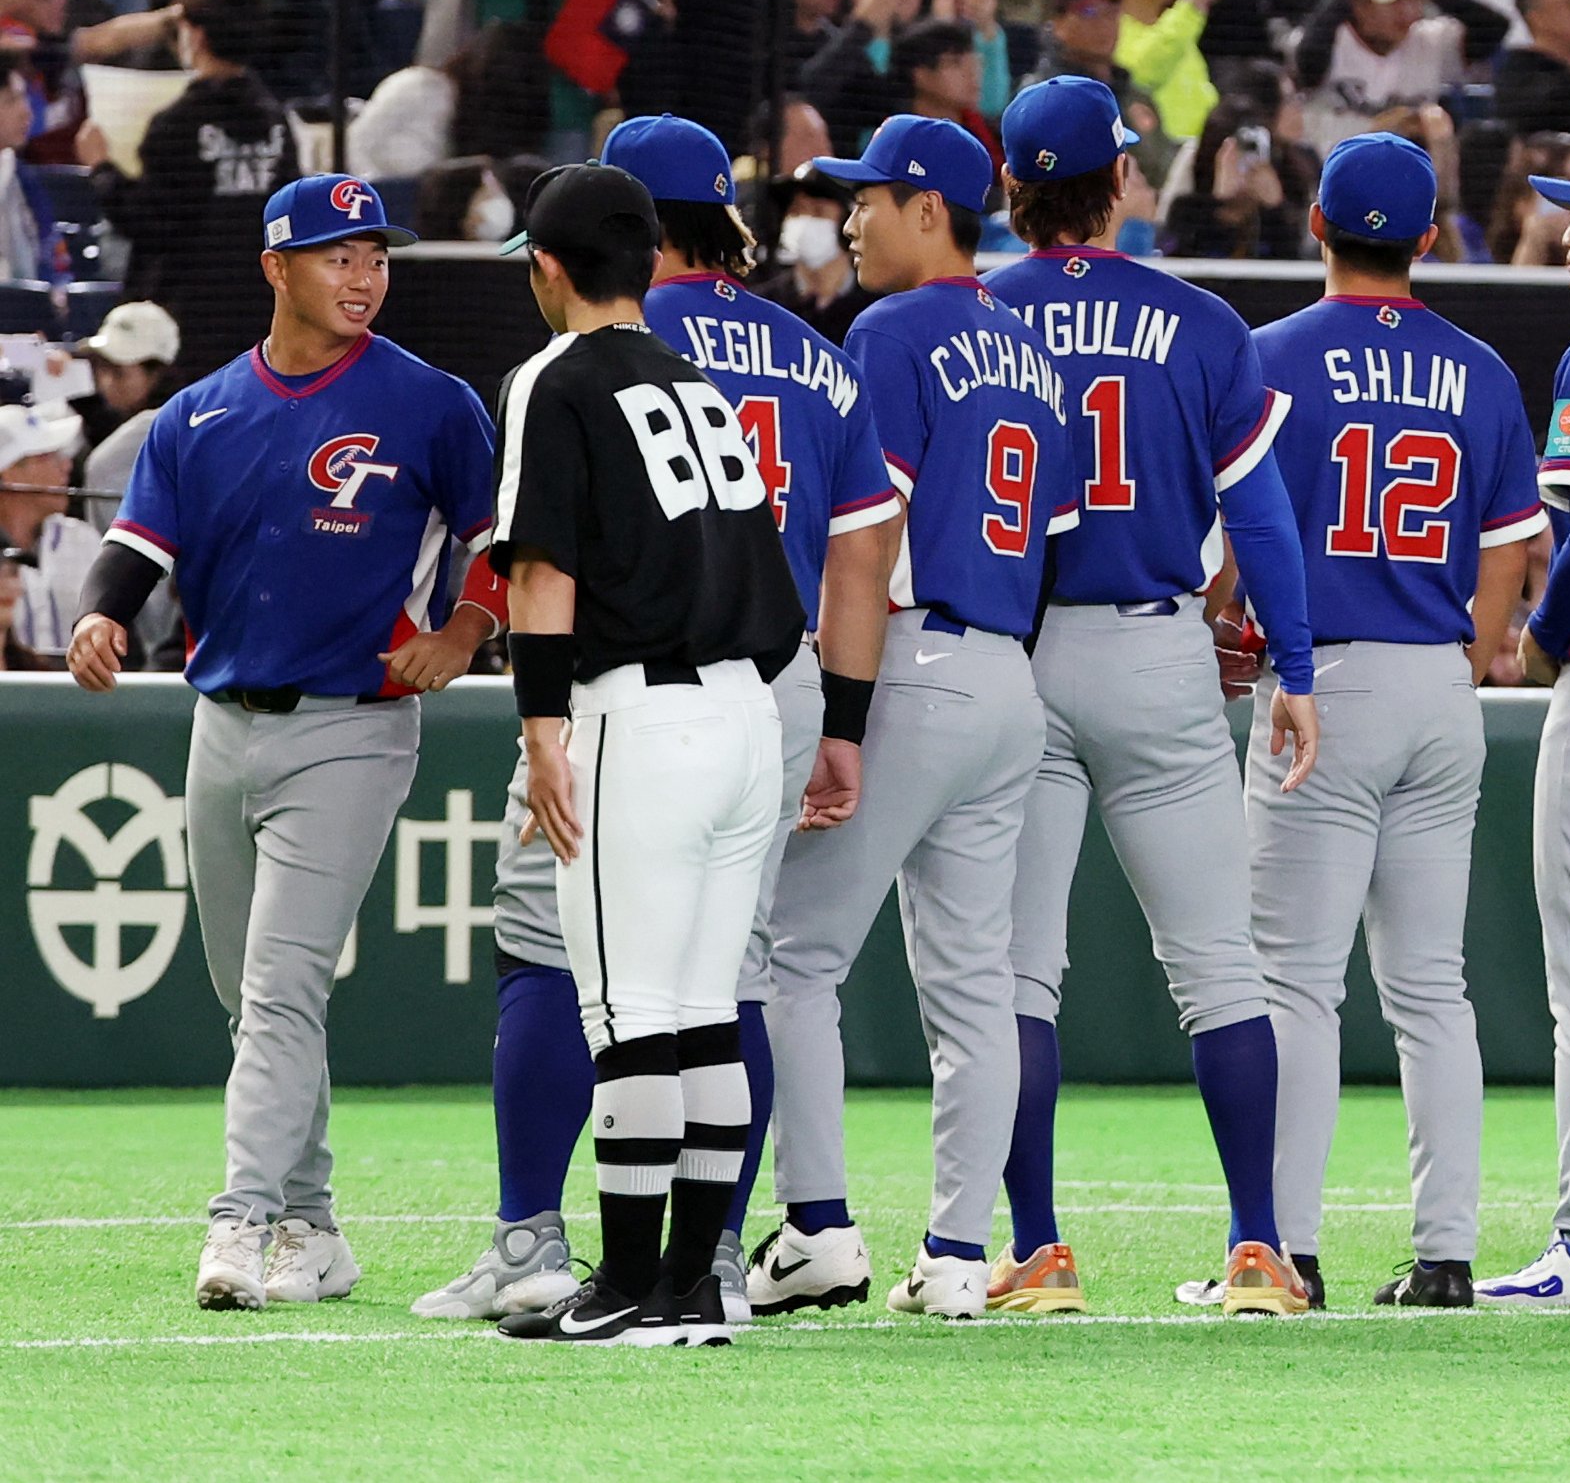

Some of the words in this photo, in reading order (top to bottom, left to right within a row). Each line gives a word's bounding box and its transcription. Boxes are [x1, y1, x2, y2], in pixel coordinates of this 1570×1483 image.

[930, 329, 1067, 426] C.Y.CHANG
[1082, 375, 1135, 510] 1
[1324, 348, 1467, 416] S.H.LIN
[613, 381, 767, 521] BB
[982, 419, 1038, 558] 9
[1325, 423, 1462, 563] 12
[314, 519, 361, 534] Taipei
